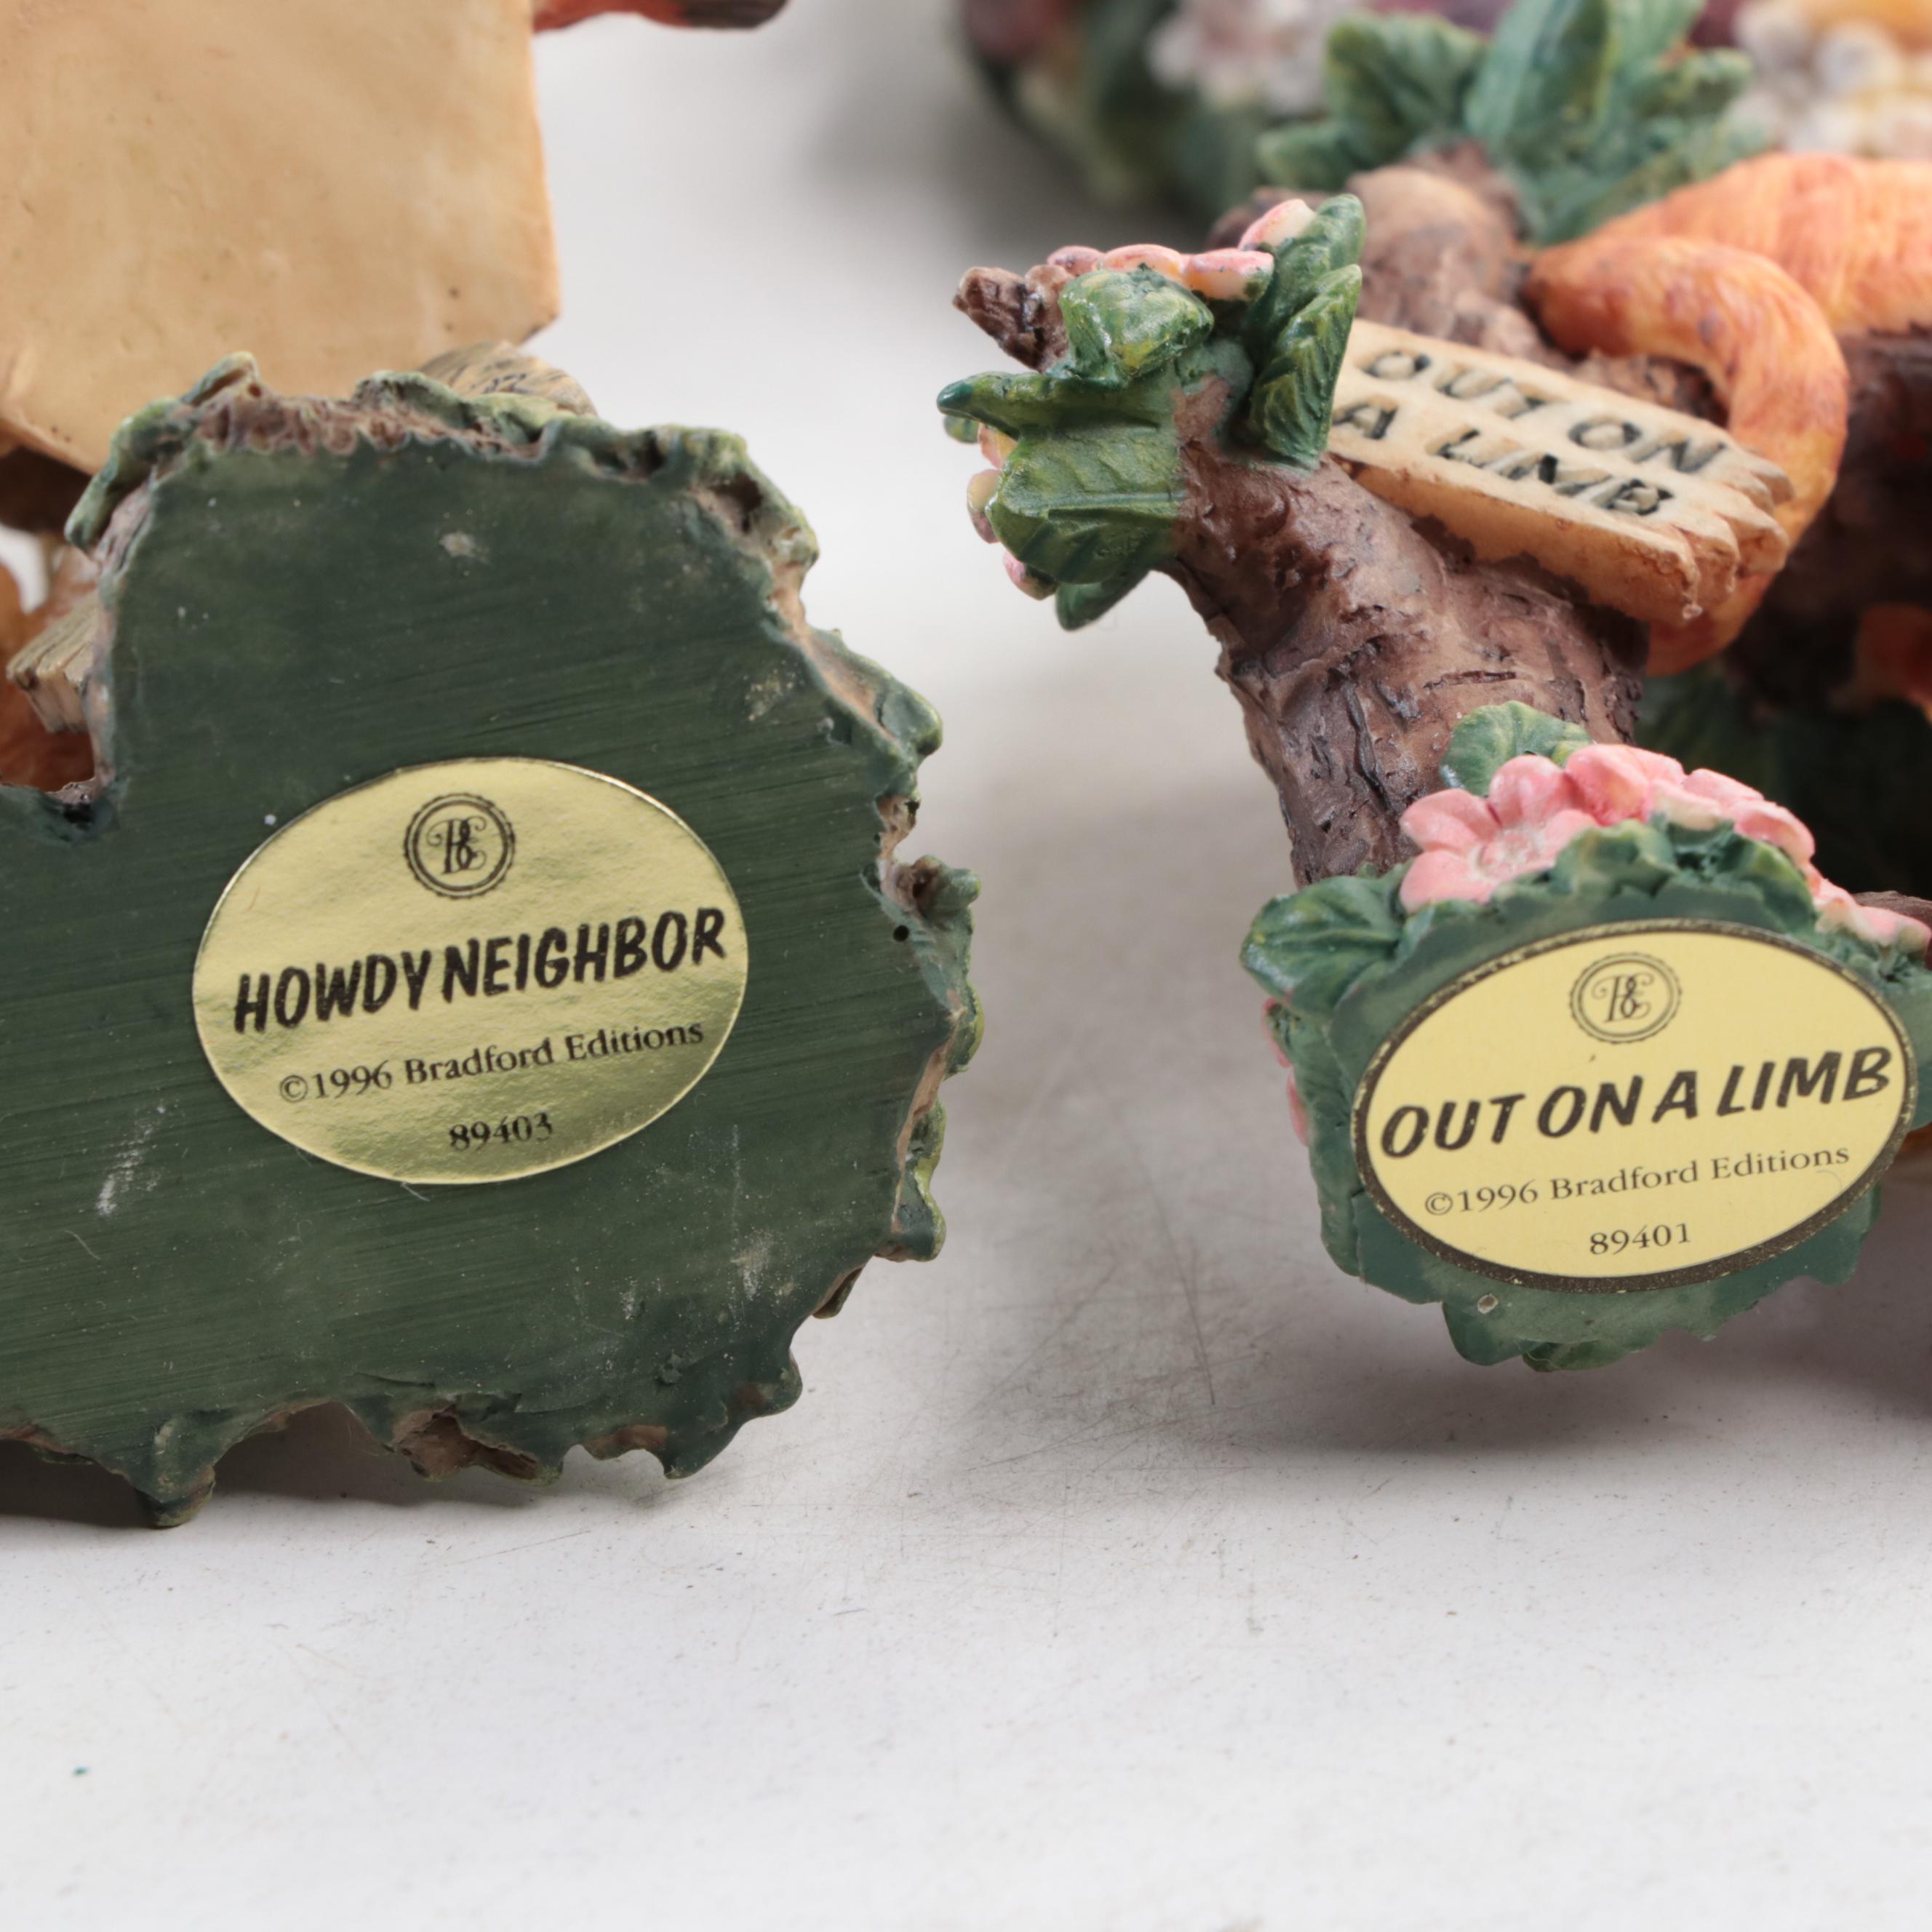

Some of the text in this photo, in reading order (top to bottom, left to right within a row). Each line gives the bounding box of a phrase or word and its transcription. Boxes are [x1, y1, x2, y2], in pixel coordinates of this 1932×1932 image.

[1334, 396, 1674, 516] A LIMB
[1359, 350, 1726, 473] OUT ON
[233, 907, 725, 1032] HOWDY NEIGHBOR
[280, 1021, 703, 1103] ©1996 Bradford Editions
[1381, 1047, 1891, 1157] OUT ON A LIMB
[450, 1112, 553, 1151] 89403
[1425, 1148, 1850, 1216] ©1996 Bradford Editions
[1589, 1222, 1690, 1256] 89401
